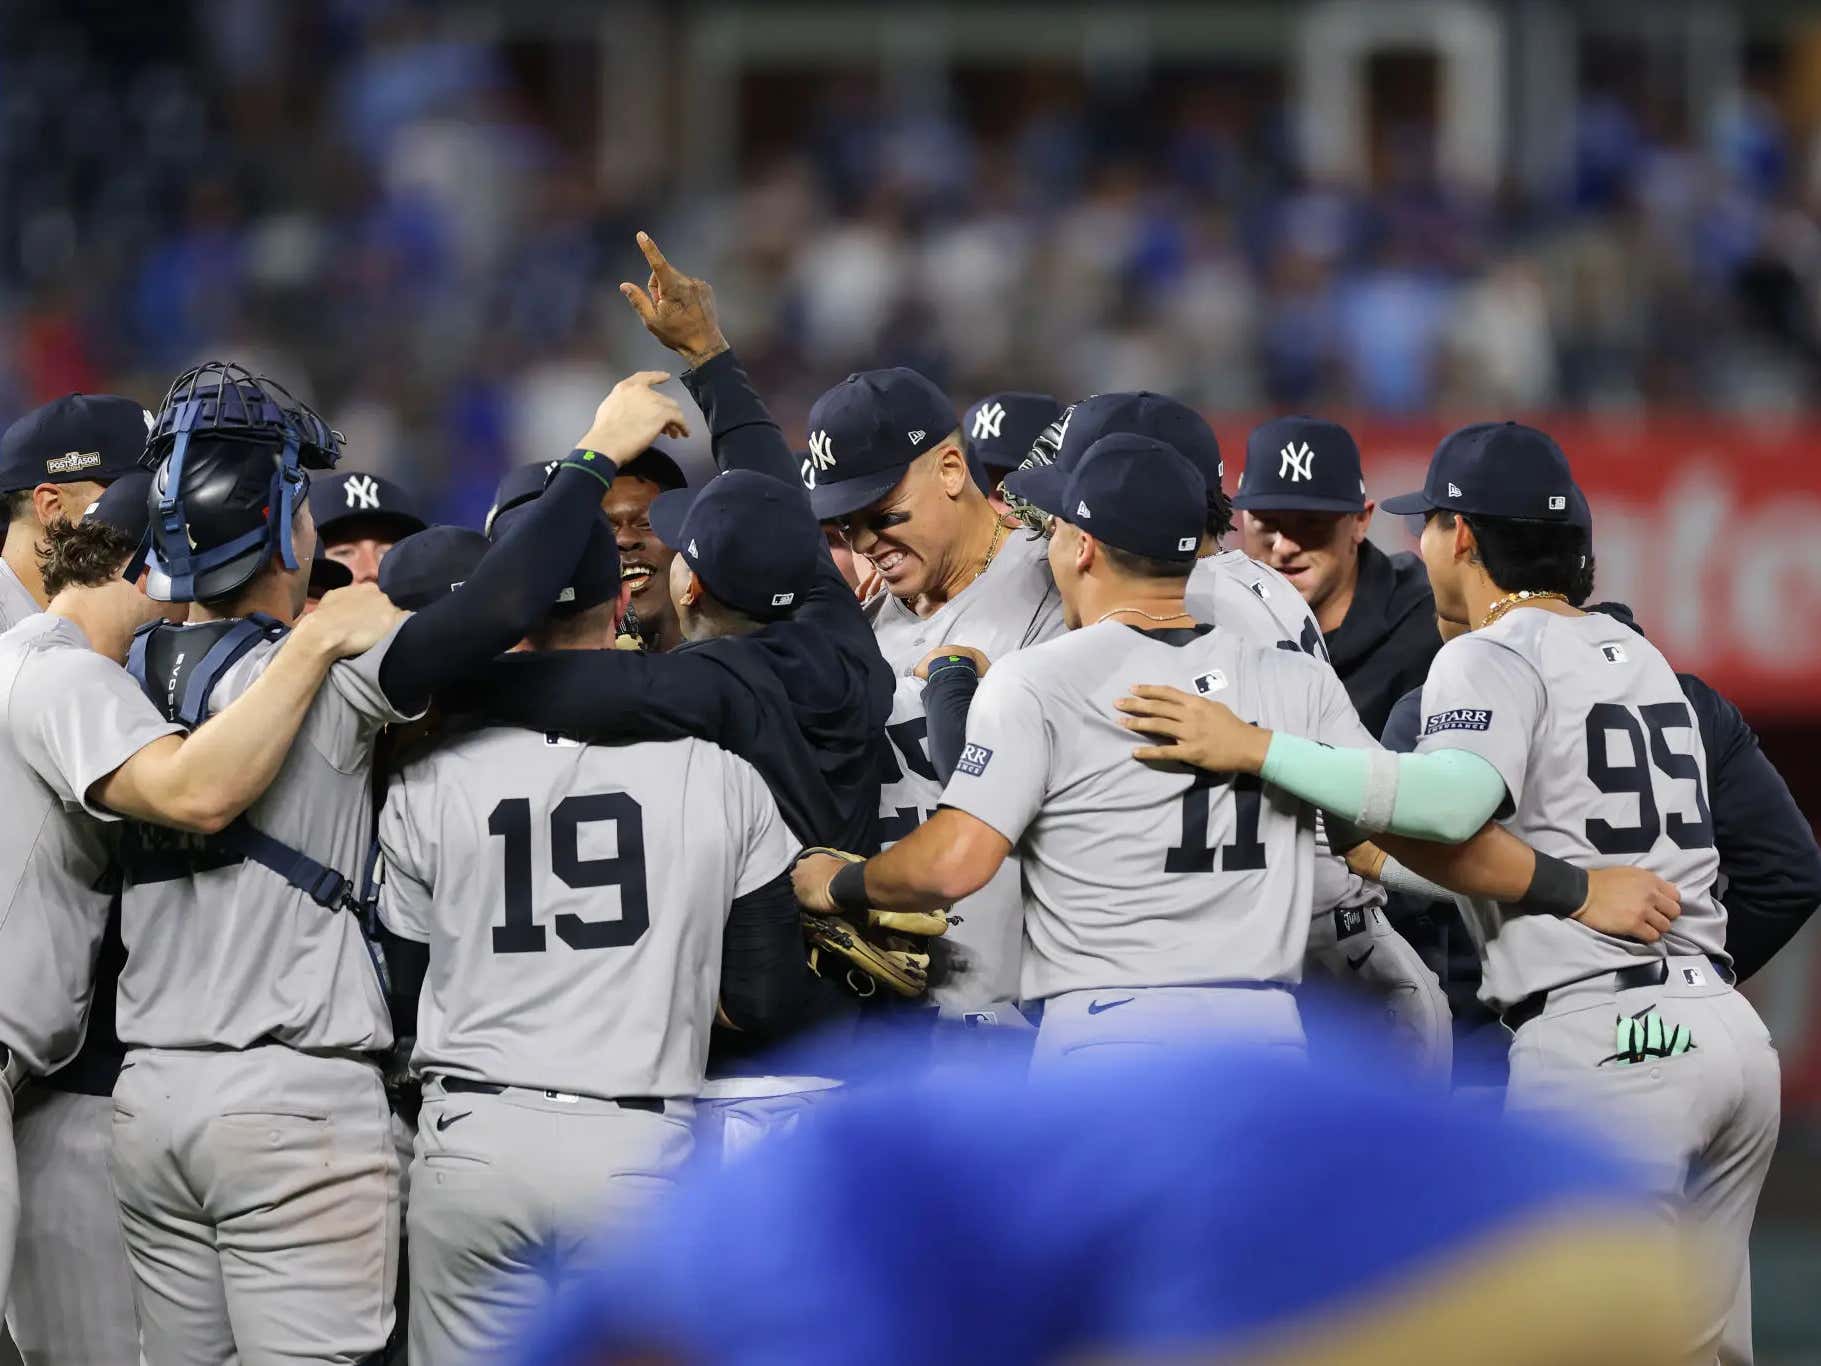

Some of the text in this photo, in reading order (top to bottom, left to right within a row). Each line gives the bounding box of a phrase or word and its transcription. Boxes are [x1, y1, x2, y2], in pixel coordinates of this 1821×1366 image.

[972, 402, 1006, 440] NY
[49, 455, 98, 470] POSTSEASON
[1279, 441, 1315, 482] NY
[344, 475, 380, 509] NY
[1429, 709, 1488, 728] STARR
[1585, 702, 1713, 855] 95
[1164, 768, 1268, 873] 11
[488, 791, 650, 954] 19
